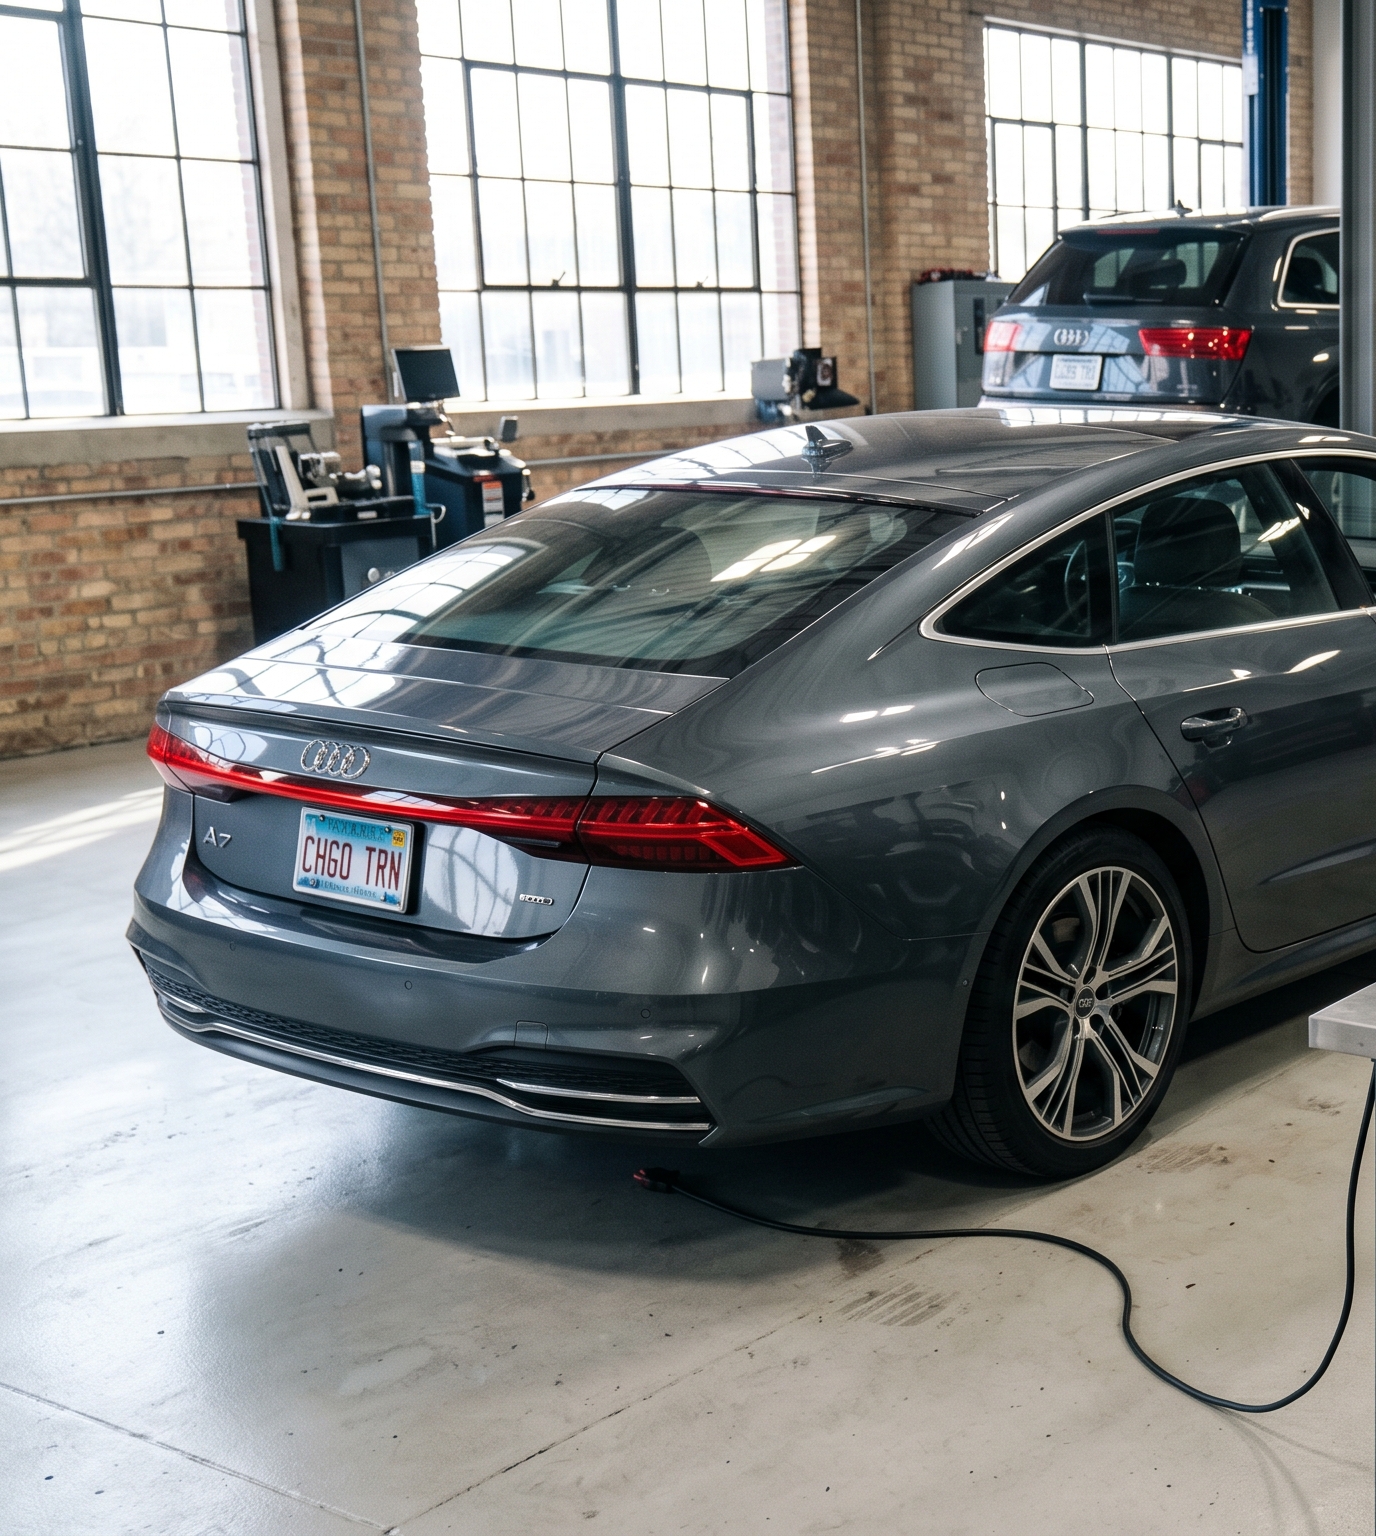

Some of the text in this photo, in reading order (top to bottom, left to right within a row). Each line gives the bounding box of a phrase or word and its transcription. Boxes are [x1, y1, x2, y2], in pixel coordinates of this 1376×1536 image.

[203, 826, 232, 848] A7
[302, 835, 353, 880] CHGO
[365, 846, 402, 891] TRN
